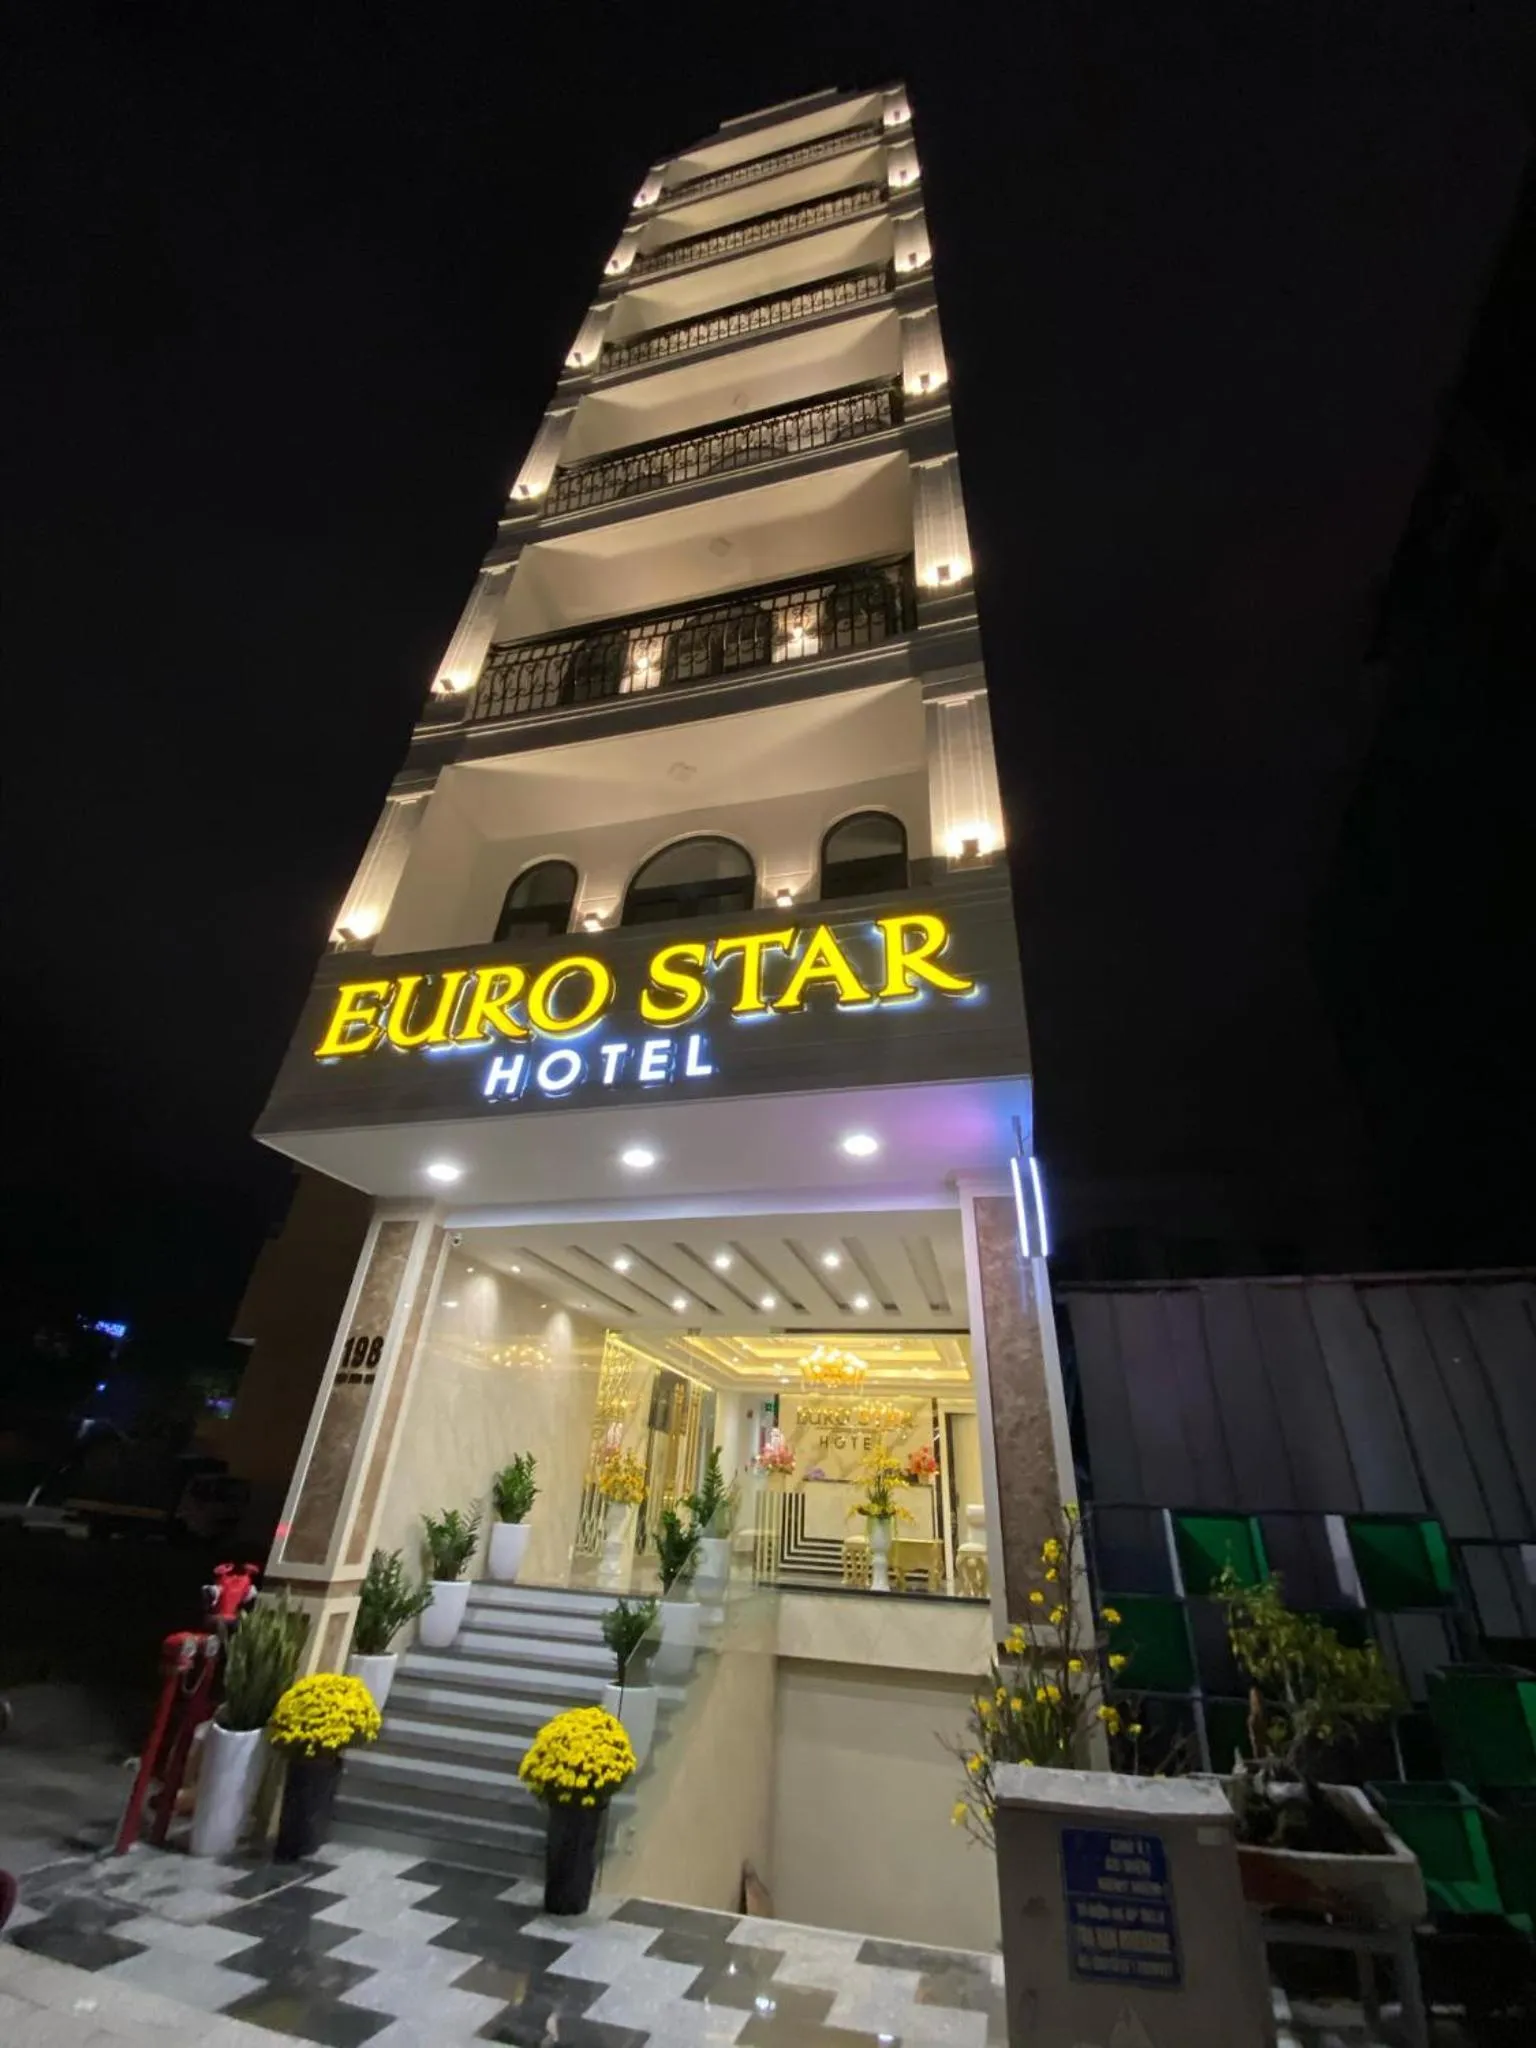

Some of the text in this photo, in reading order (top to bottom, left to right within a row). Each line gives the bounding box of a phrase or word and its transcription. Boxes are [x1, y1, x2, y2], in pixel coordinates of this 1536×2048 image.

[314, 914, 974, 1060] EURO STAR
[483, 1036, 716, 1099] HOTEL
[340, 1335, 384, 1369] 198
